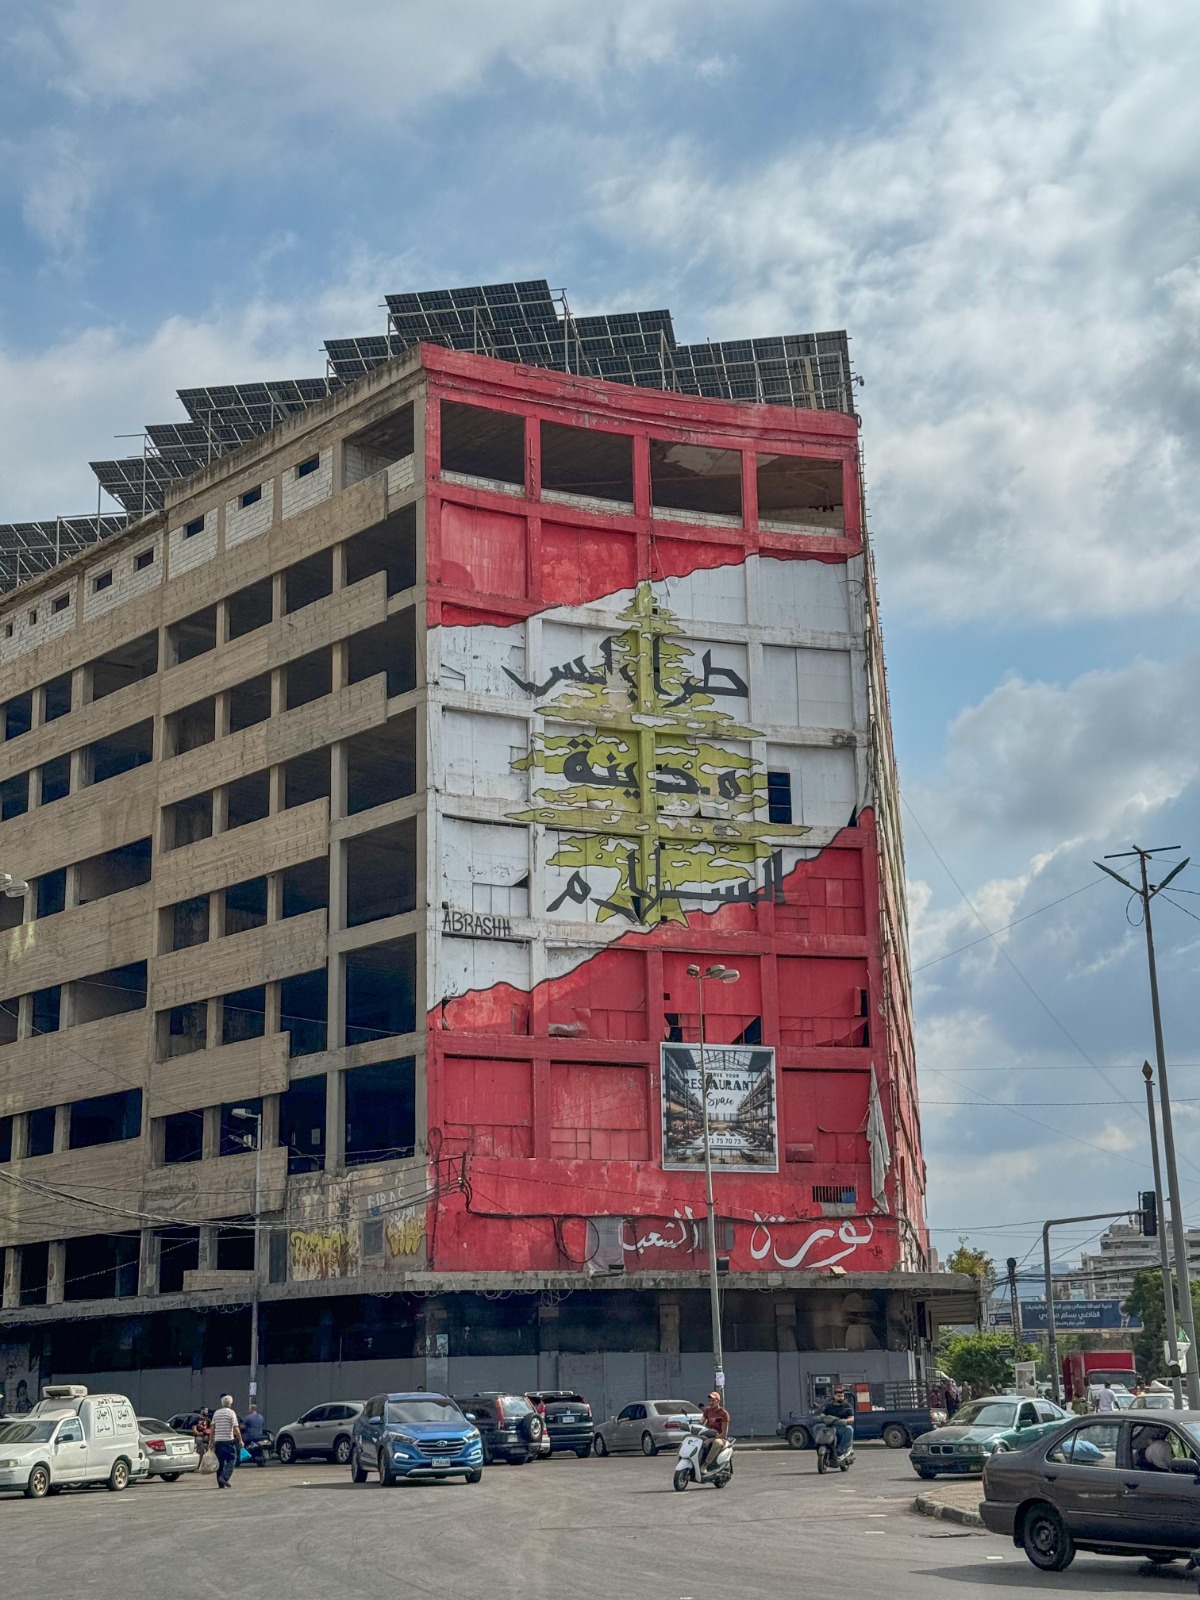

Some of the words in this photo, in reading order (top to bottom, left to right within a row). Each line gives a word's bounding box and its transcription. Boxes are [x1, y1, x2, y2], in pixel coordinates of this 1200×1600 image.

[563, 737, 742, 800] مدينة
[546, 846, 785, 925] السلام
[684, 1078, 758, 1091] RESAURANT
[706, 1092, 734, 1109] Space
[1077, 1311, 1101, 1320] القاضي
